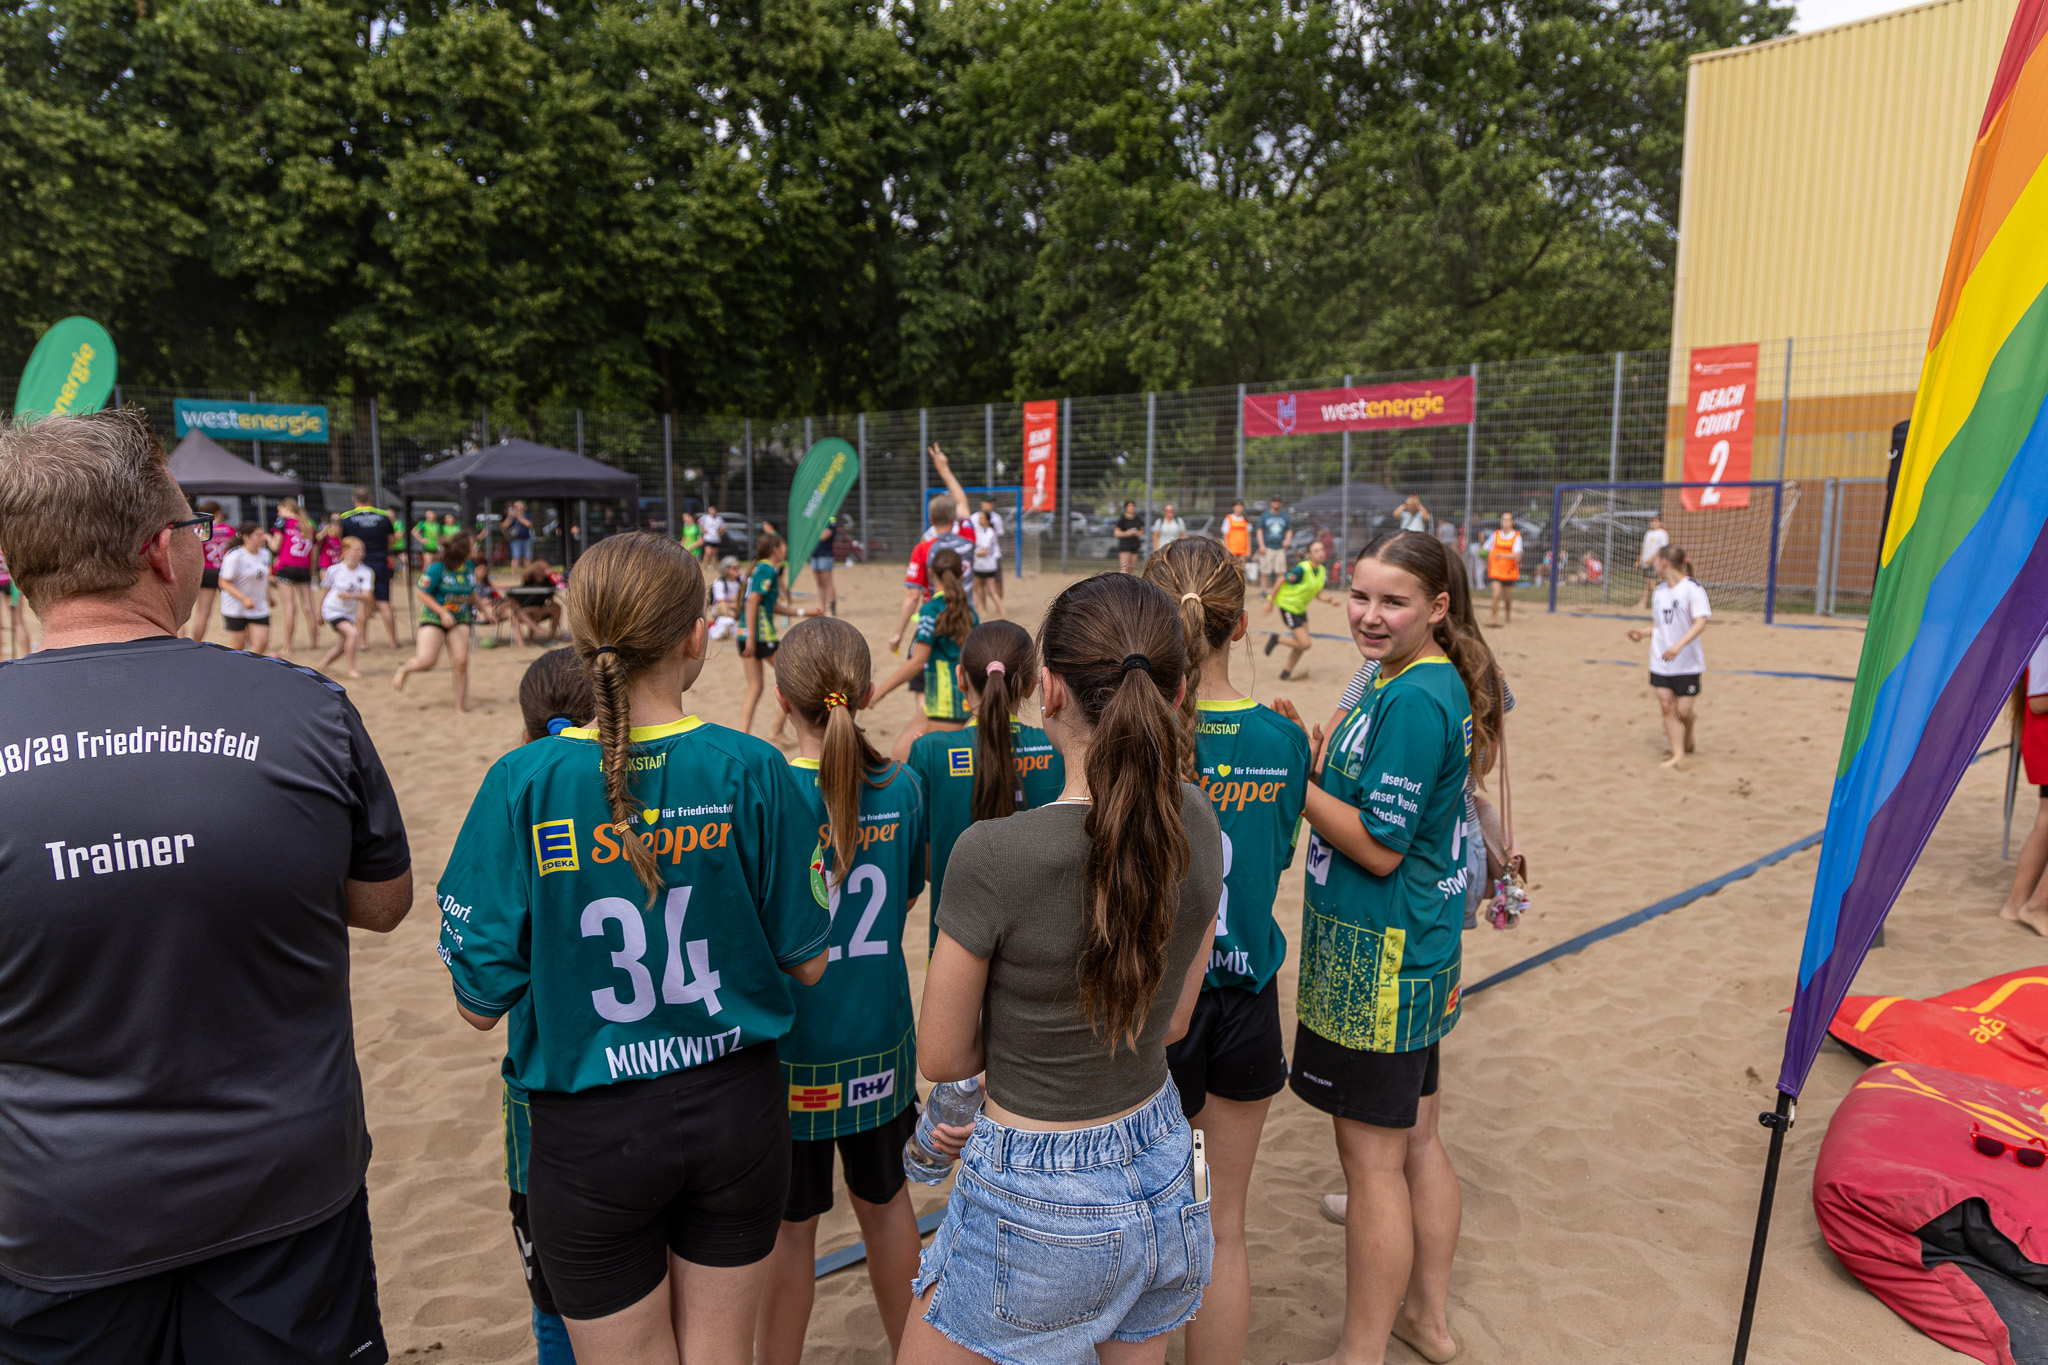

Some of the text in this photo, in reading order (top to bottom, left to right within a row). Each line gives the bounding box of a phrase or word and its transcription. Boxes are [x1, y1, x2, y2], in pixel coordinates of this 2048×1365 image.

[50, 343, 96, 415] nergie
[1321, 390, 1444, 421] westenergie
[1696, 384, 1746, 413] BEACH
[181, 409, 323, 437] westenergie
[1694, 409, 1745, 438] COURT
[1700, 440, 1730, 506] 2
[76, 725, 260, 762] Friedrichsfeld
[1203, 766, 1214, 774] mit
[1246, 766, 1288, 777] Friedrichsfeld
[662, 808, 675, 818] für
[45, 833, 194, 880] Trainer
[591, 821, 733, 866] Sepper
[542, 859, 575, 872] EDEKA
[580, 886, 723, 1022] 34
[605, 1026, 743, 1079] MINKWITZ
[852, 1074, 892, 1101] R+V
